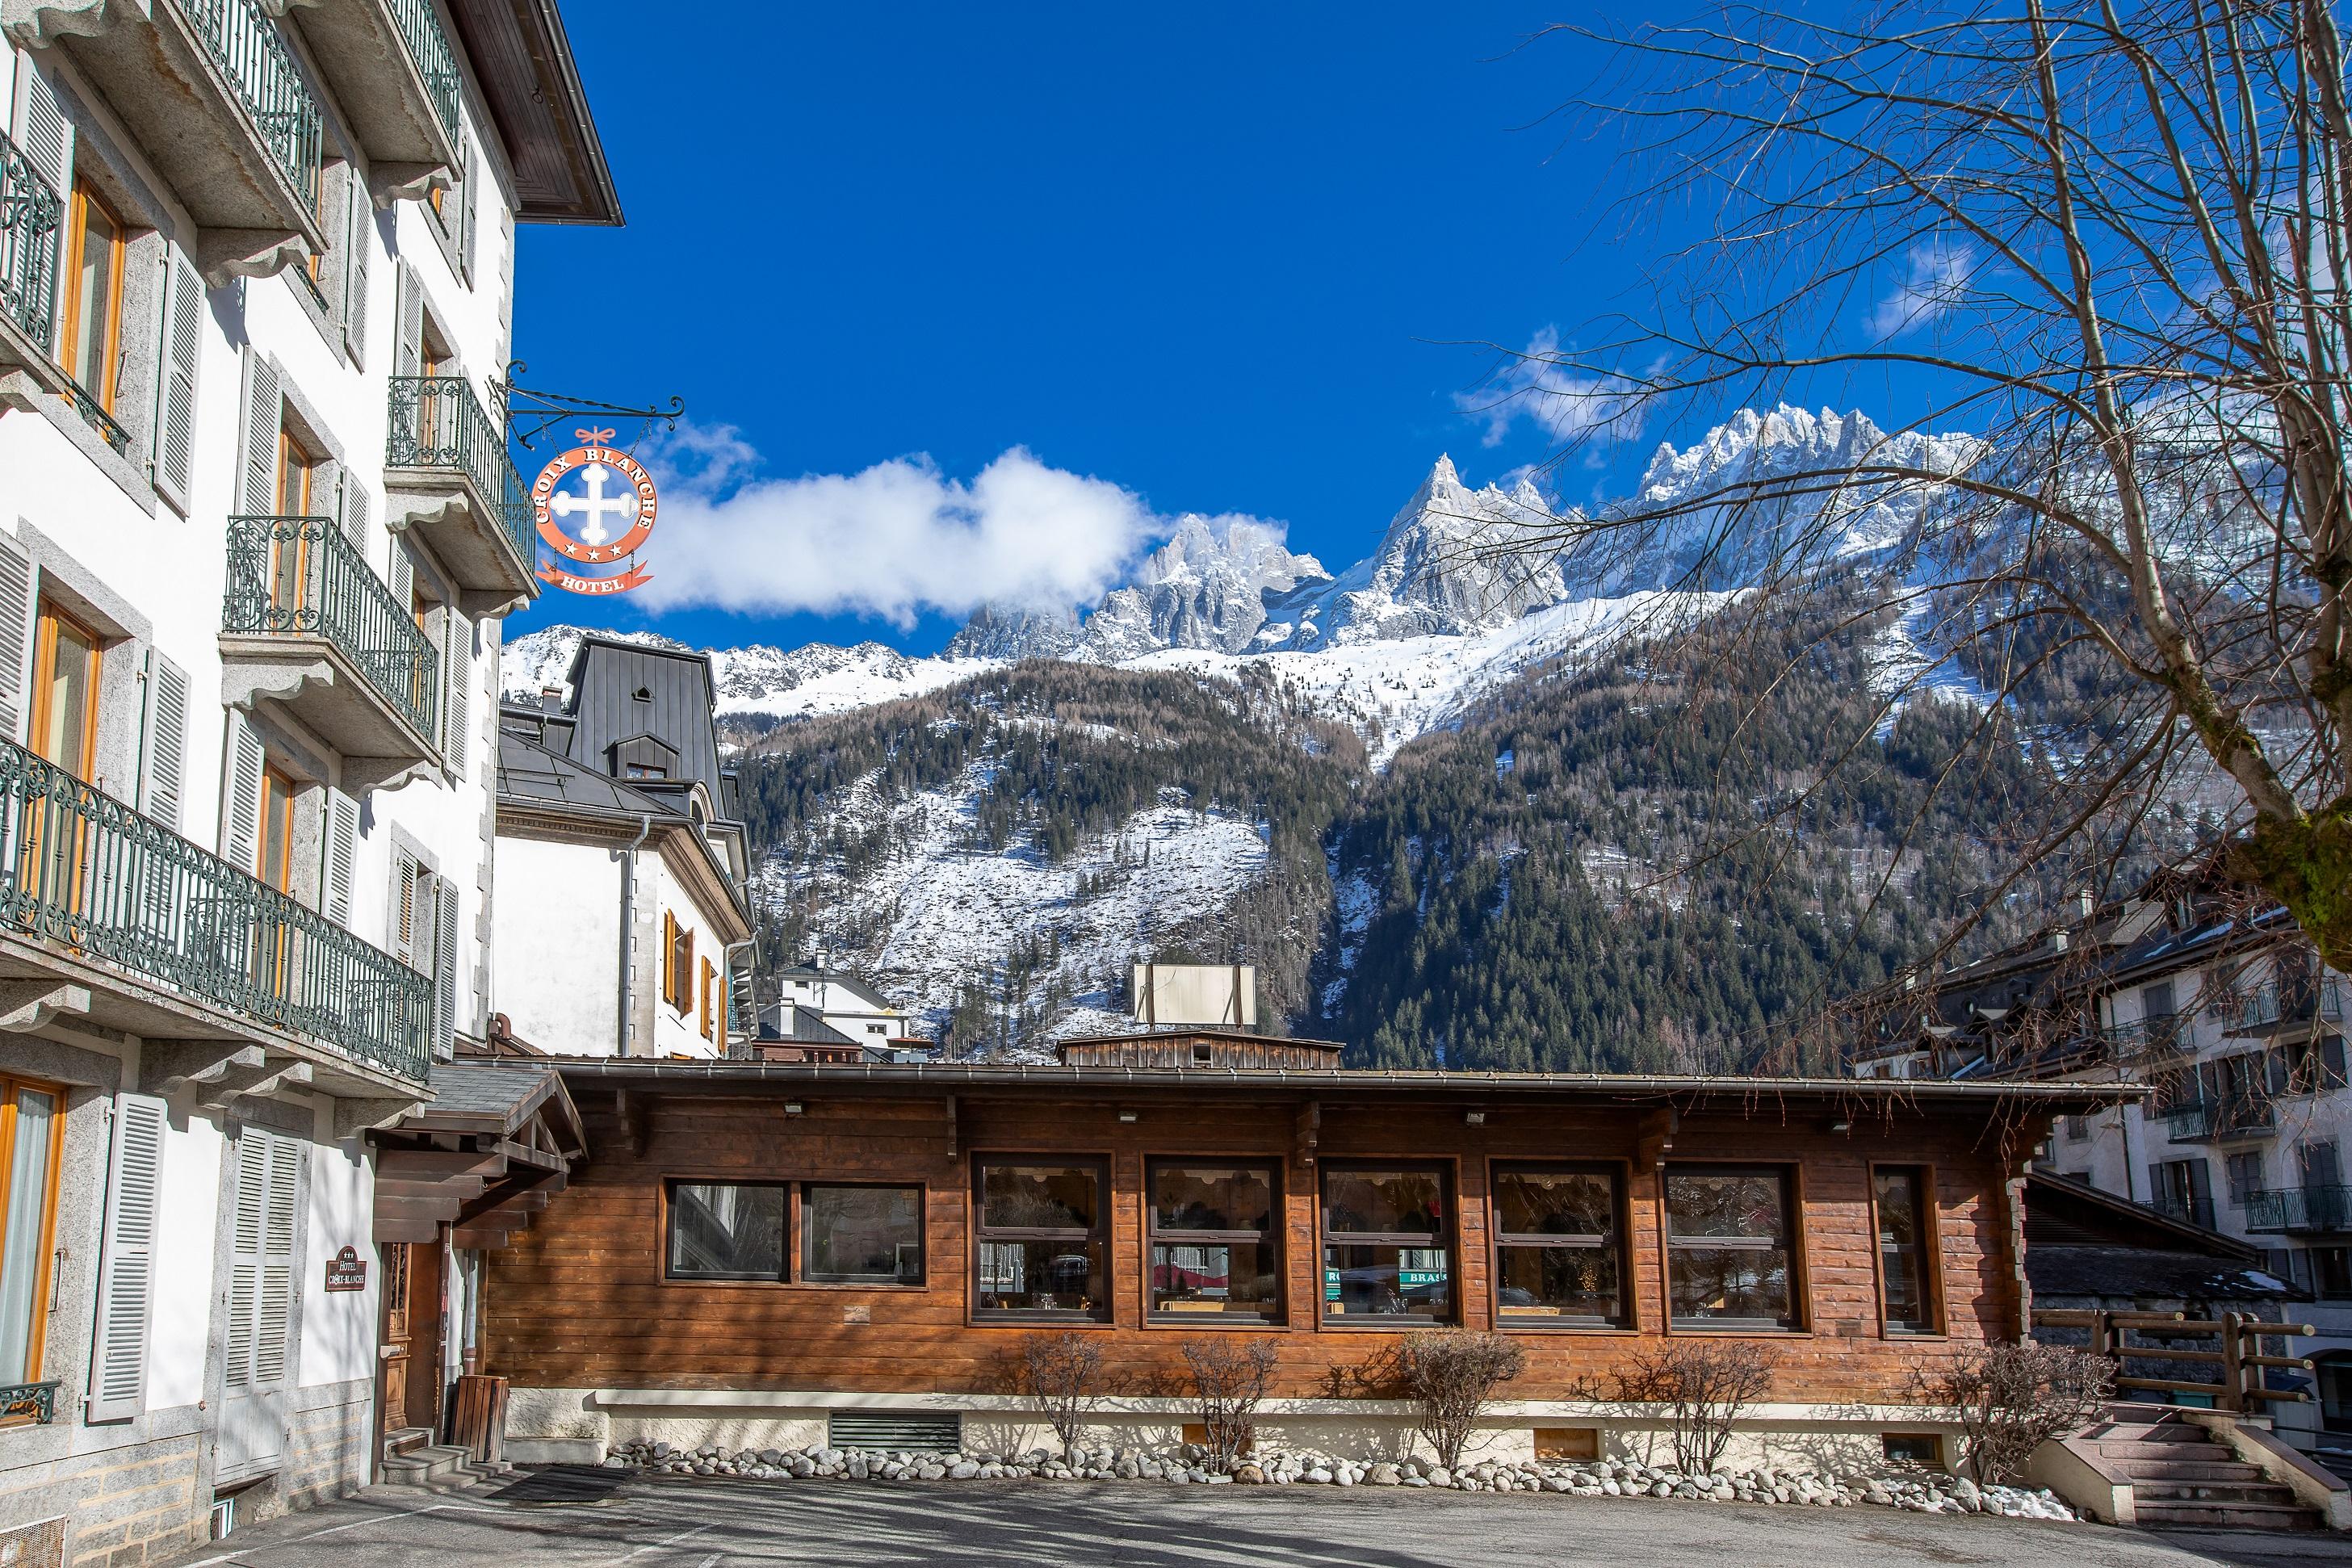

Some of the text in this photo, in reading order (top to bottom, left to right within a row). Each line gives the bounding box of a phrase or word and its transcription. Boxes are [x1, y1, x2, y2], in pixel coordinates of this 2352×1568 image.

[534, 449, 655, 530] CROIX BLANCHE
[560, 575, 625, 593] HOTEL
